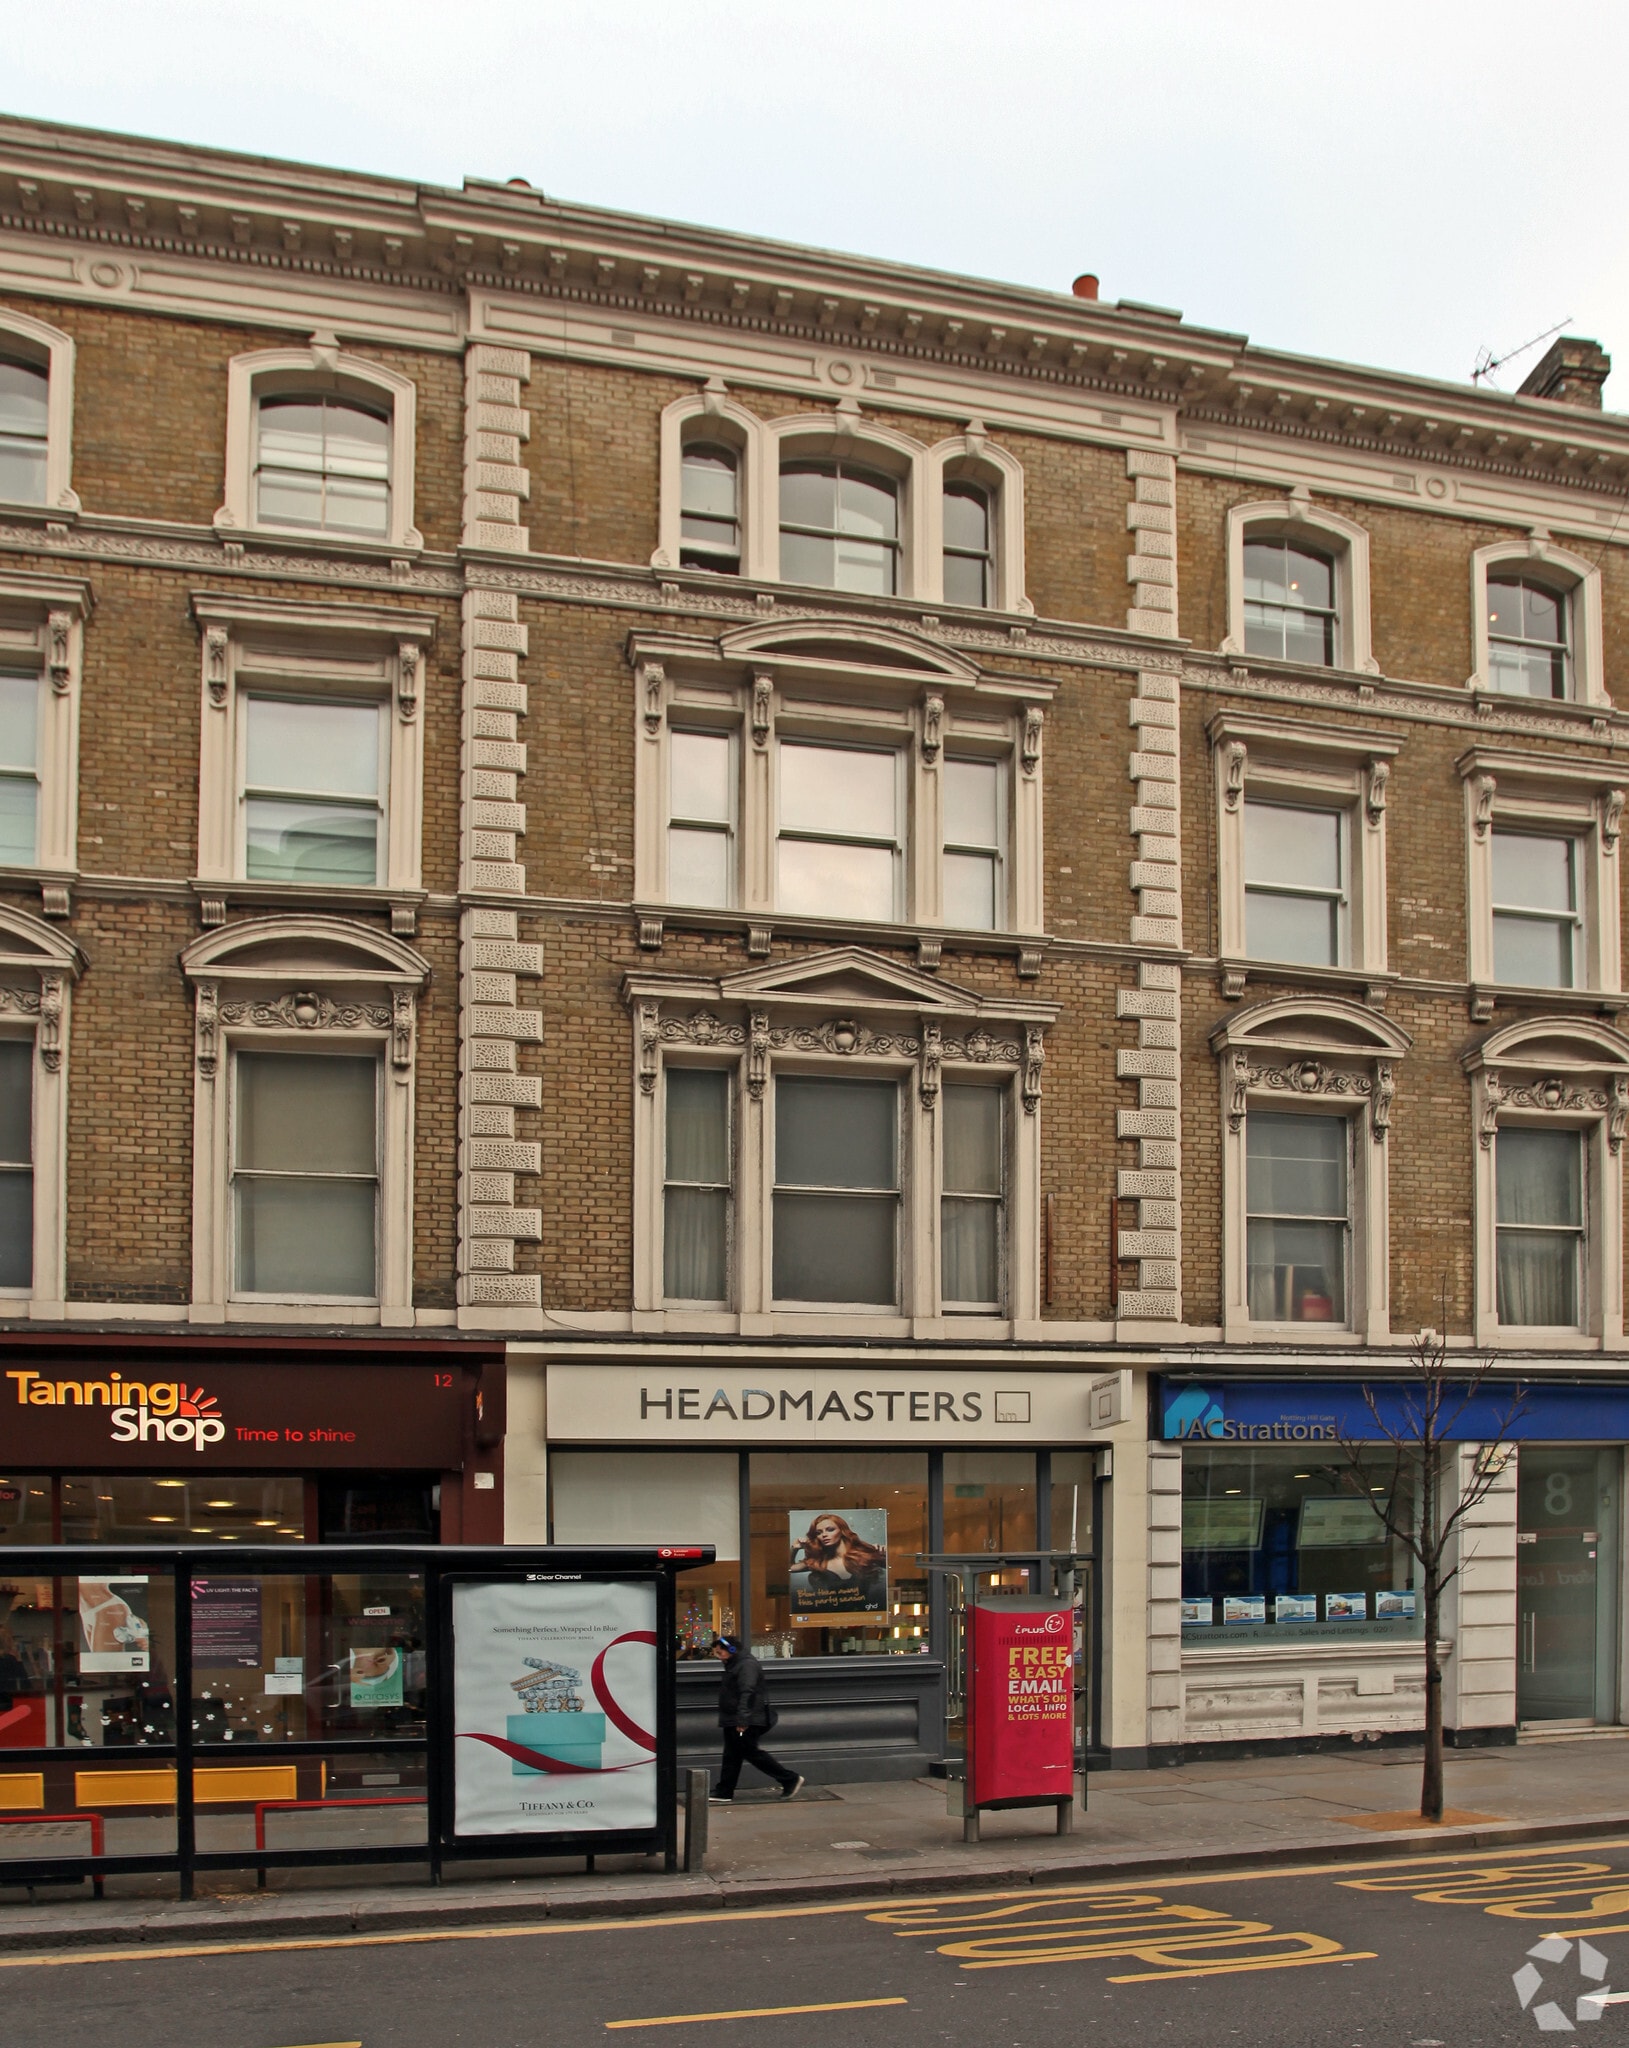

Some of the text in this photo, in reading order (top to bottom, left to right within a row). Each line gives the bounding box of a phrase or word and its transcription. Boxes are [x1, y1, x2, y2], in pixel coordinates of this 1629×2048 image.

[434, 1375, 453, 1387] 12
[6, 1371, 178, 1416] Tanning
[641, 1388, 982, 1421] HEADMASTERS
[1280, 1414, 1306, 1422] Notting
[110, 1406, 225, 1451] Shop
[235, 1428, 356, 1442] Time to shine
[1545, 1473, 1573, 1515] 8
[347, 1617, 405, 1626] Welcome
[493, 1626, 531, 1634] Something
[560, 1625, 592, 1633] Wrapped
[1299, 1628, 1319, 1636] Sales
[1320, 1627, 1335, 1635] and
[1337, 1626, 1369, 1635] Lettings
[1009, 1646, 1068, 1665] FREE
[1008, 1666, 1068, 1679] & EASY
[1009, 1679, 1067, 1694] EMAIL
[1008, 1694, 1067, 1704] WHAT'S ON
[1008, 1703, 1067, 1712] LOCAL INFO
[1042, 1712, 1067, 1720] MORE
[519, 1801, 565, 1811] TIFFANY
[566, 1801, 575, 1809] &
[865, 1895, 1345, 1969] STOP
